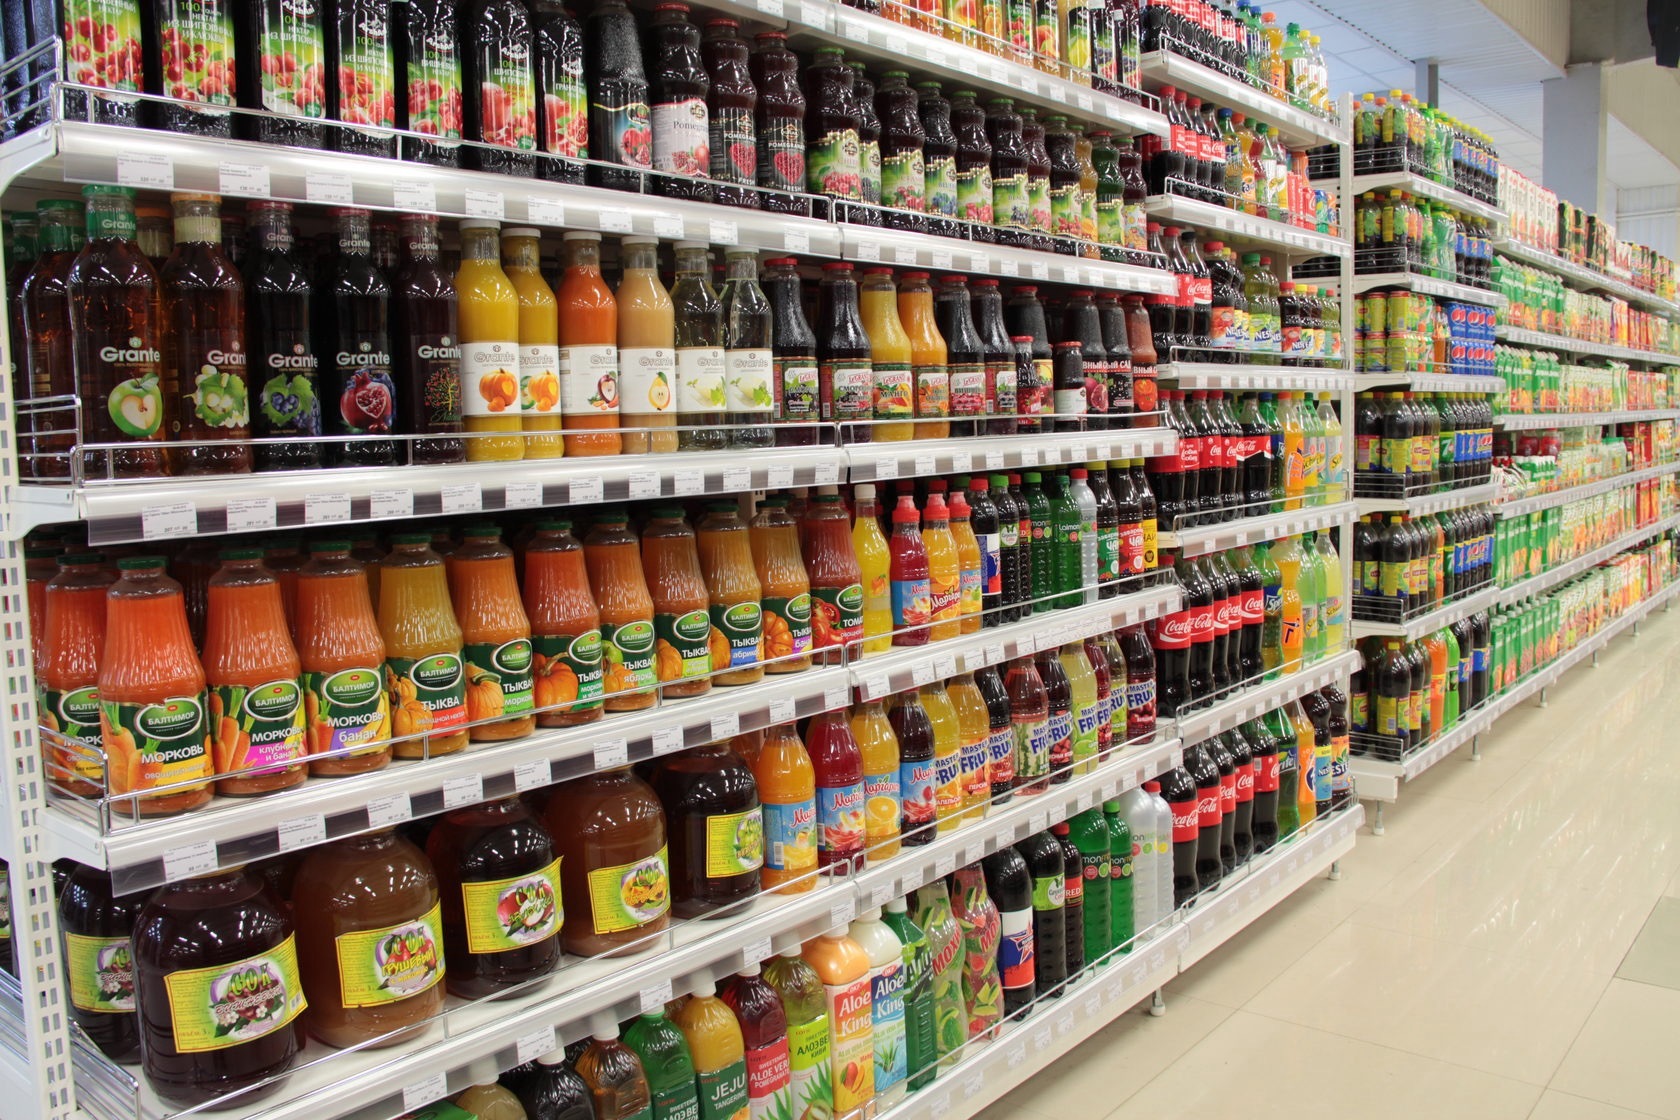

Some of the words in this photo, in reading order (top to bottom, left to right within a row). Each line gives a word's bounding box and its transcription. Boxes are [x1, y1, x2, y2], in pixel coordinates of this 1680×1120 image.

[100, 346, 160, 362] Grante
[268, 353, 318, 369] Grante
[336, 351, 389, 367] Grante
[474, 352, 515, 363] Grante
[639, 356, 673, 367] Grante
[732, 358, 768, 368] Grante
[731, 612, 760, 621] БАЛТИМОР
[420, 666, 457, 678] БАЛТИМОР
[333, 681, 375, 693] БАЛТИМОР
[255, 693, 296, 708] БАЛТИМОР
[421, 697, 460, 711] ТЫКВА
[148, 711, 195, 727] БАЛТИМОР
[339, 730, 377, 743] банан
[141, 745, 204, 765] МОРКОВЬ
[392, 926, 425, 955] СОК
[382, 947, 435, 977] ГРУШЕВЫЙ
[229, 962, 272, 996] СОК
[875, 975, 904, 999] Aloe
[839, 991, 871, 1017] Aloe
[877, 994, 905, 1018] King
[841, 1013, 873, 1037] King
[750, 1069, 774, 1082] ALOE
[711, 1073, 746, 1101] JEJU
